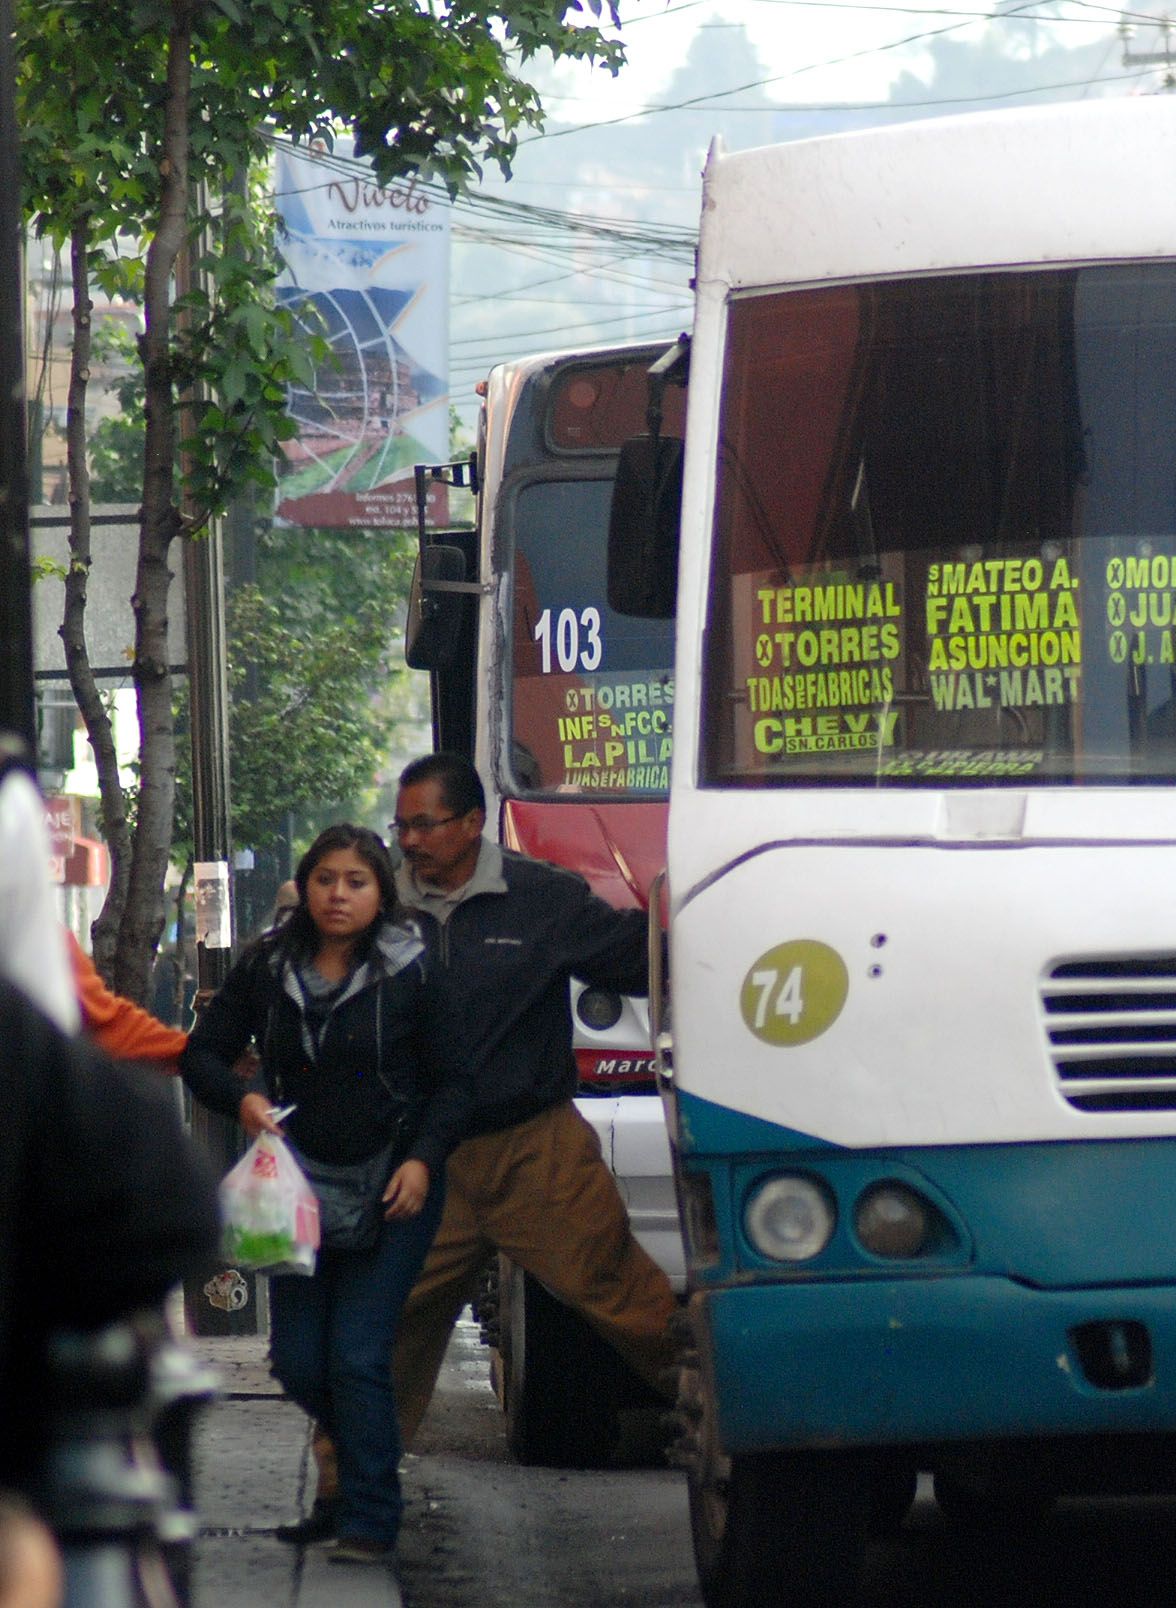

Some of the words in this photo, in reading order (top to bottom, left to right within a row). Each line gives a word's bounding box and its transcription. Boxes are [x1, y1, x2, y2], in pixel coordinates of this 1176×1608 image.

[327, 218, 386, 232] Atractivos
[942, 558, 1044, 594] MATEO
[1050, 558, 1079, 589] A.
[757, 582, 901, 624] TERMINAL
[926, 591, 1080, 635] FATIMA
[534, 607, 602, 673] 103
[774, 623, 900, 667] TORRES
[928, 630, 1081, 671] ASUNCION
[579, 681, 675, 712] TORRES
[564, 744, 601, 769] LA
[604, 737, 673, 766] PILA
[753, 712, 898, 754] CHEVY
[815, 733, 878, 750] CARLOS
[752, 967, 804, 1029] 74
